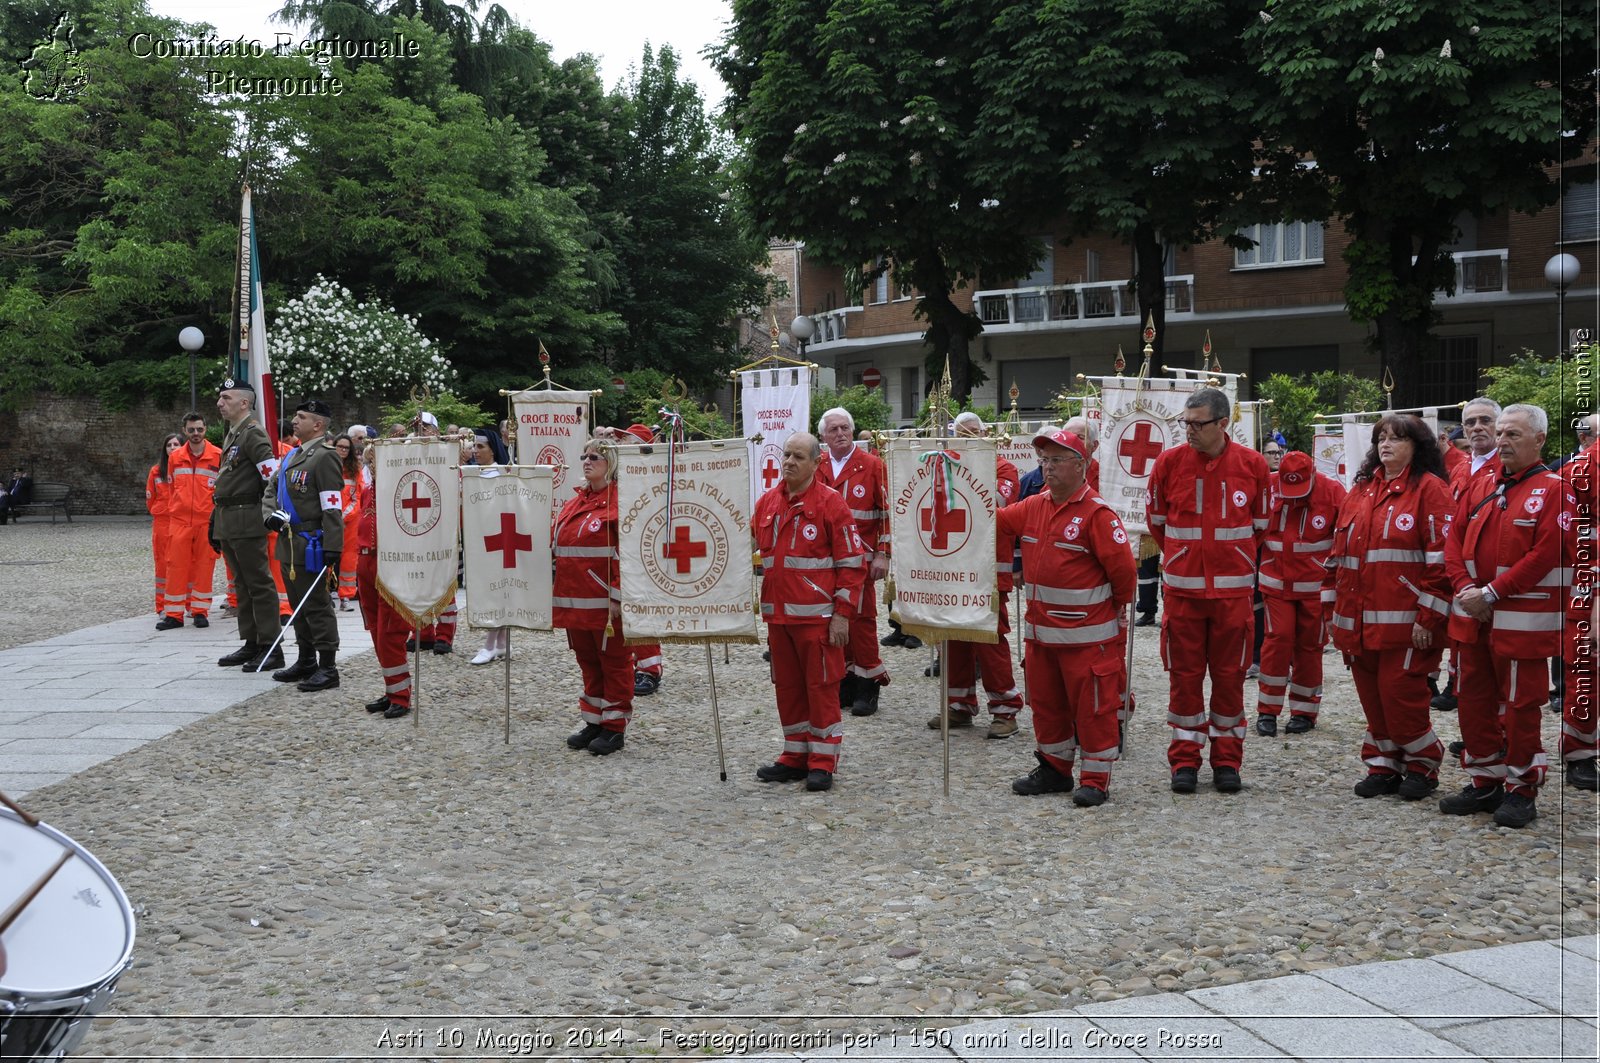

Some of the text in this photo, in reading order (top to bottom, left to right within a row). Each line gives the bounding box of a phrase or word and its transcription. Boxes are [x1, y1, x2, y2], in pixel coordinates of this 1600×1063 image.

[521, 414, 581, 425] CROCE ROSSA
[774, 409, 792, 418] ROSSA
[530, 427, 571, 437] ITALIANA
[1013, 443, 1035, 451] ROSS
[626, 465, 648, 475] CORPO
[691, 462, 704, 472] DEL
[707, 458, 742, 470] SOCCORSO
[896, 475, 918, 515] CROCE
[957, 465, 994, 518] ITALIANA
[1121, 486, 1147, 498] GRUPP
[621, 493, 651, 534] CROCE
[700, 482, 747, 532] ITALIANA
[643, 505, 726, 593] CONVENZIONE DI INEVRA 22 AGOSTO 1864
[911, 569, 979, 582] DELEGAZIONE DI
[623, 602, 751, 615] COMITATO PROVINCIALE
